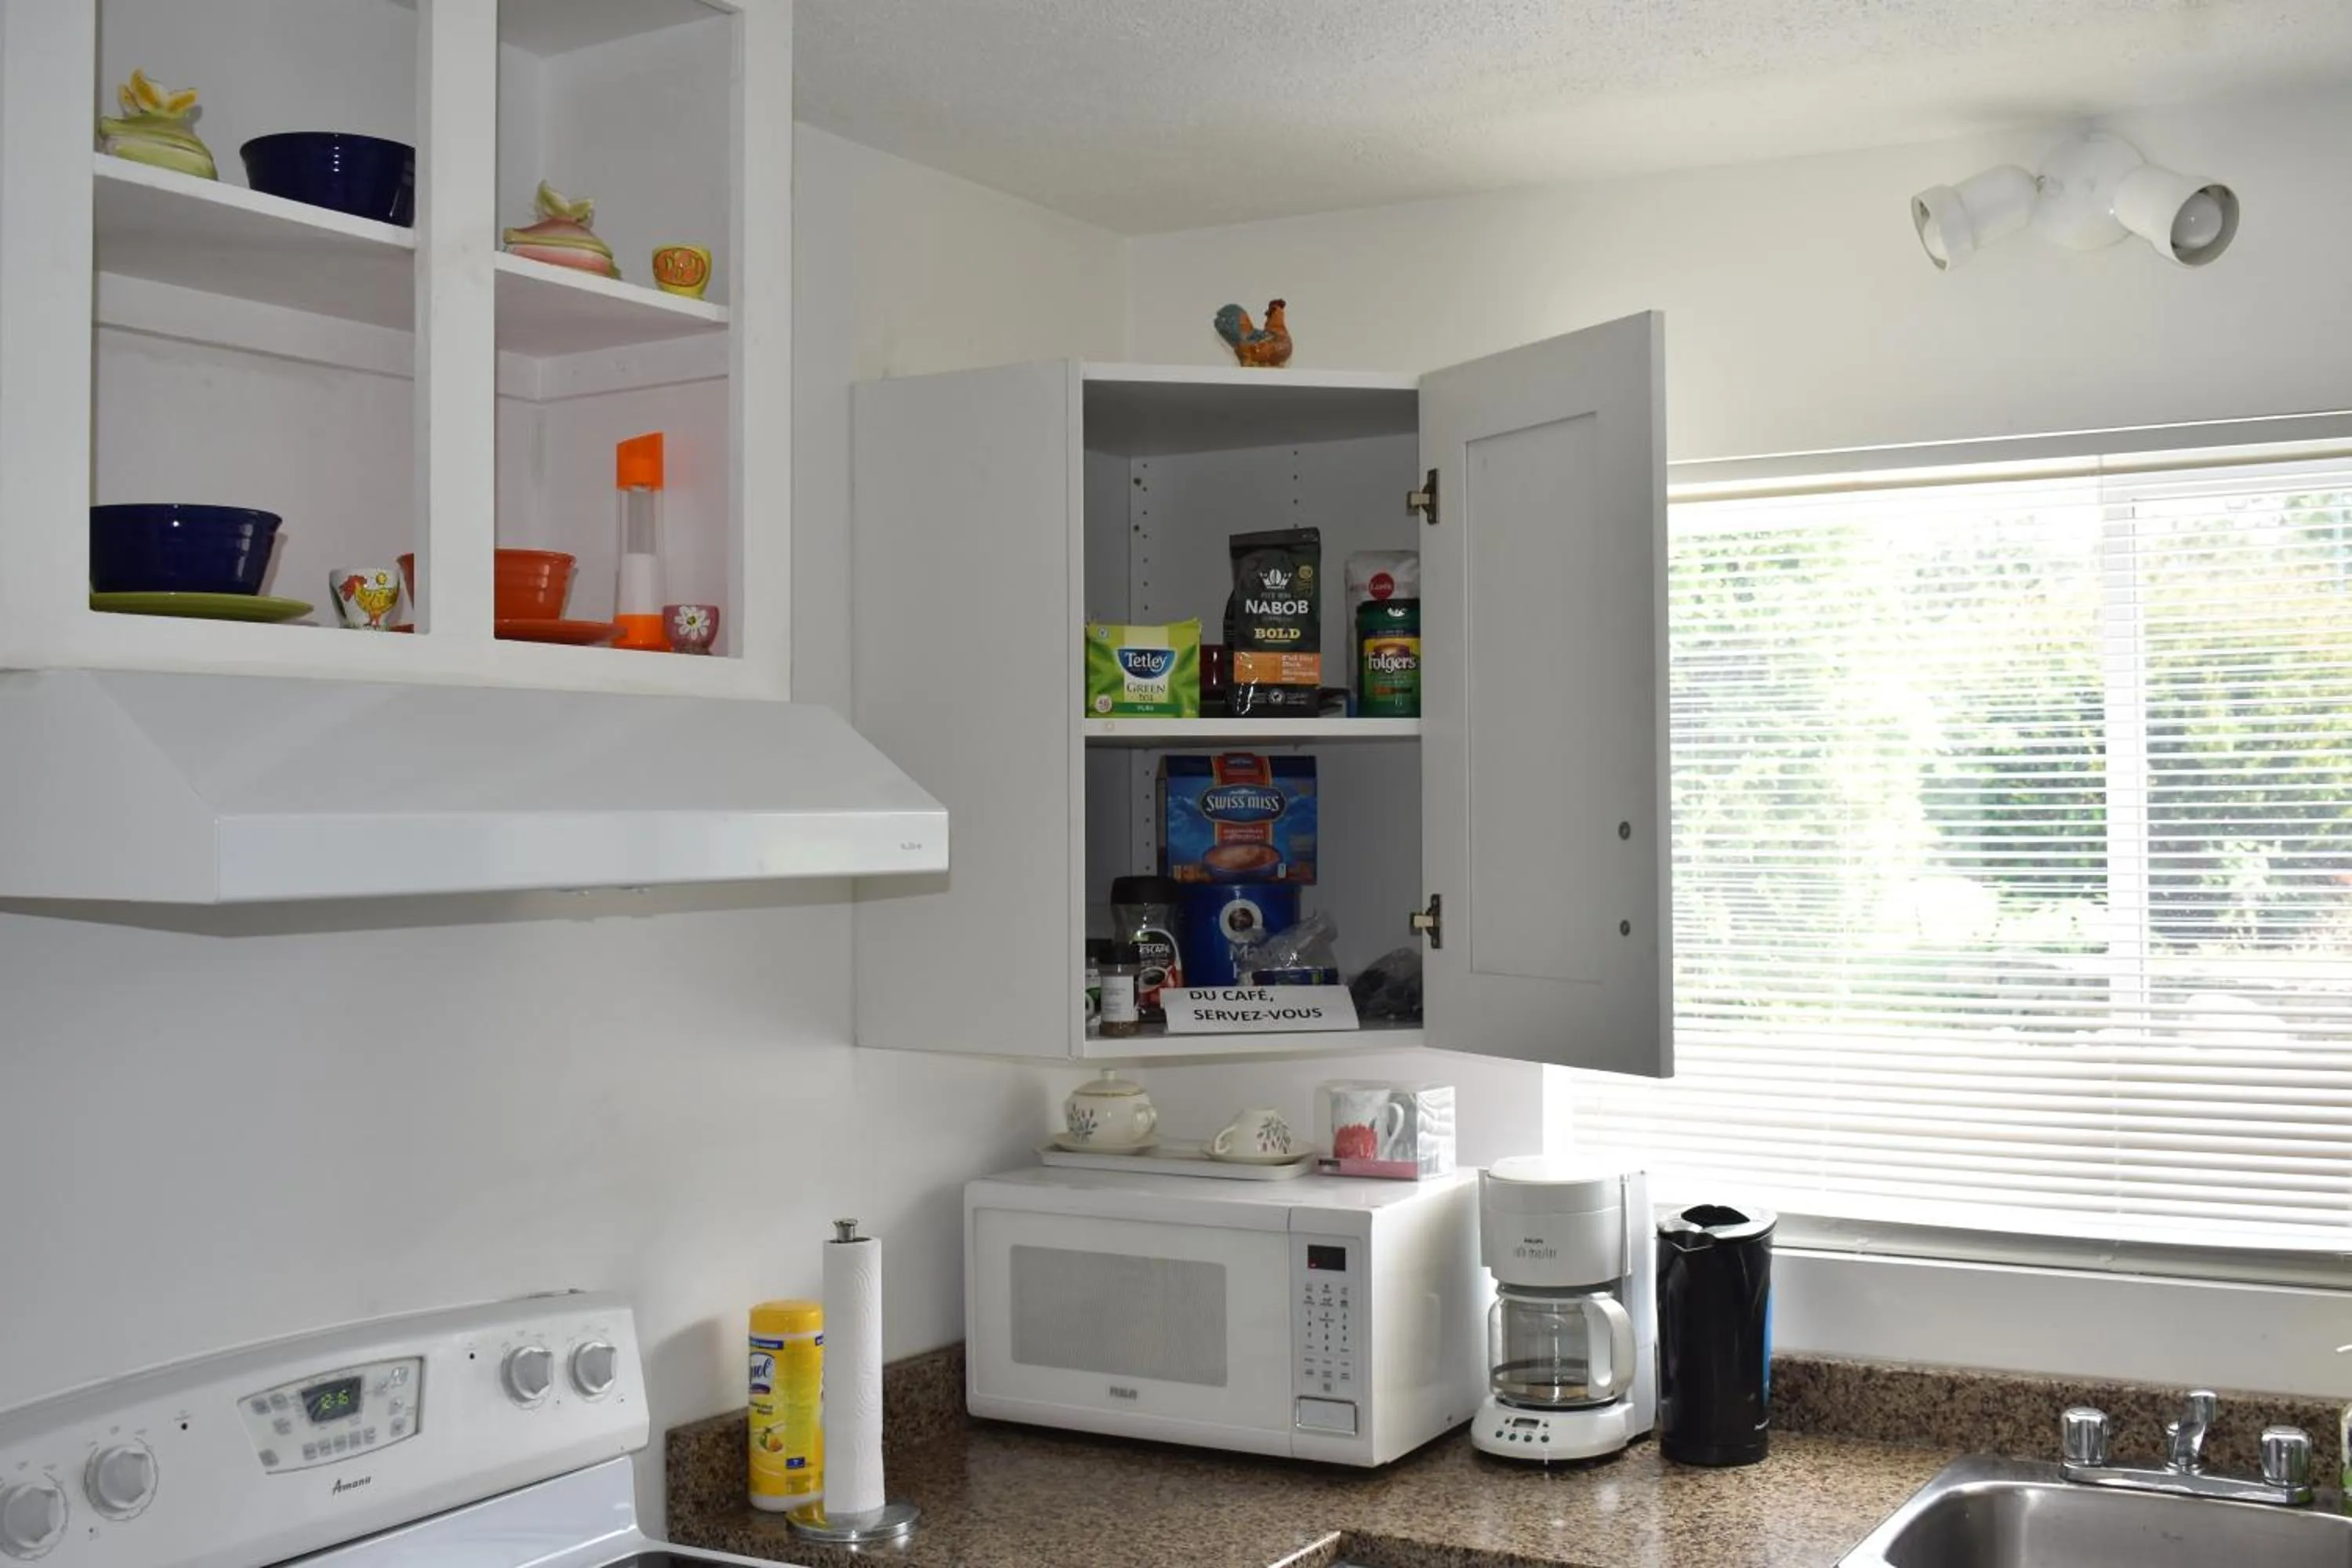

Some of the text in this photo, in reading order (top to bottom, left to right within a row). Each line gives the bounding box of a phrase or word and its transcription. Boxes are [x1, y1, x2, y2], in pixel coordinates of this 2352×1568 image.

[1245, 600, 1308, 615] NABOB
[1254, 628, 1301, 639] BOLD
[1126, 652, 1167, 673] Tetley
[1367, 652, 1417, 673] Folgers
[1127, 682, 1166, 694] GREEN
[1189, 988, 1274, 1003] DU CAFÉ,
[1193, 1007, 1323, 1022] SERVEZ-VOUS
